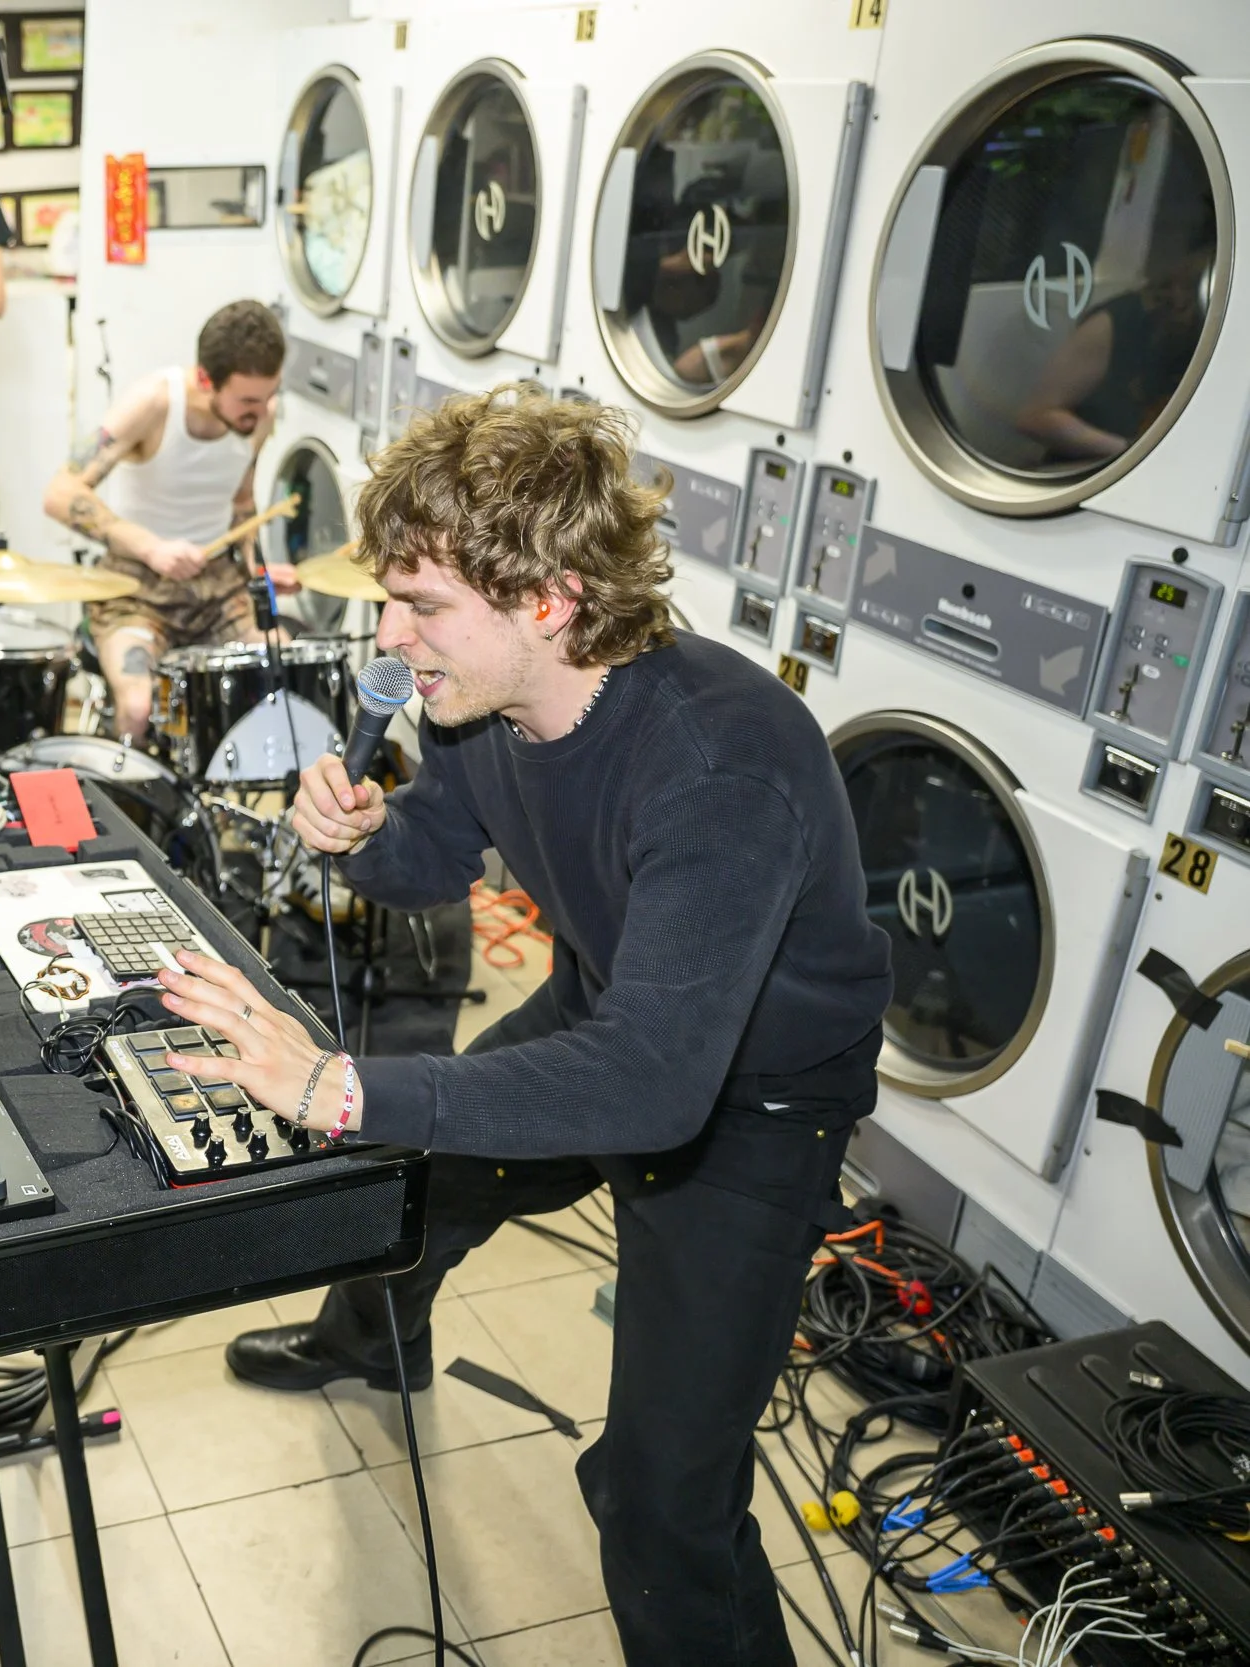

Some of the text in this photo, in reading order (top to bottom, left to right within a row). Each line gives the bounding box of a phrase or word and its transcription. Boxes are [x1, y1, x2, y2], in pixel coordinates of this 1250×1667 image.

[855, 0, 882, 26] 14
[781, 655, 808, 693] 29
[1163, 838, 1211, 887] 28
[164, 1134, 192, 1161] AKAI
